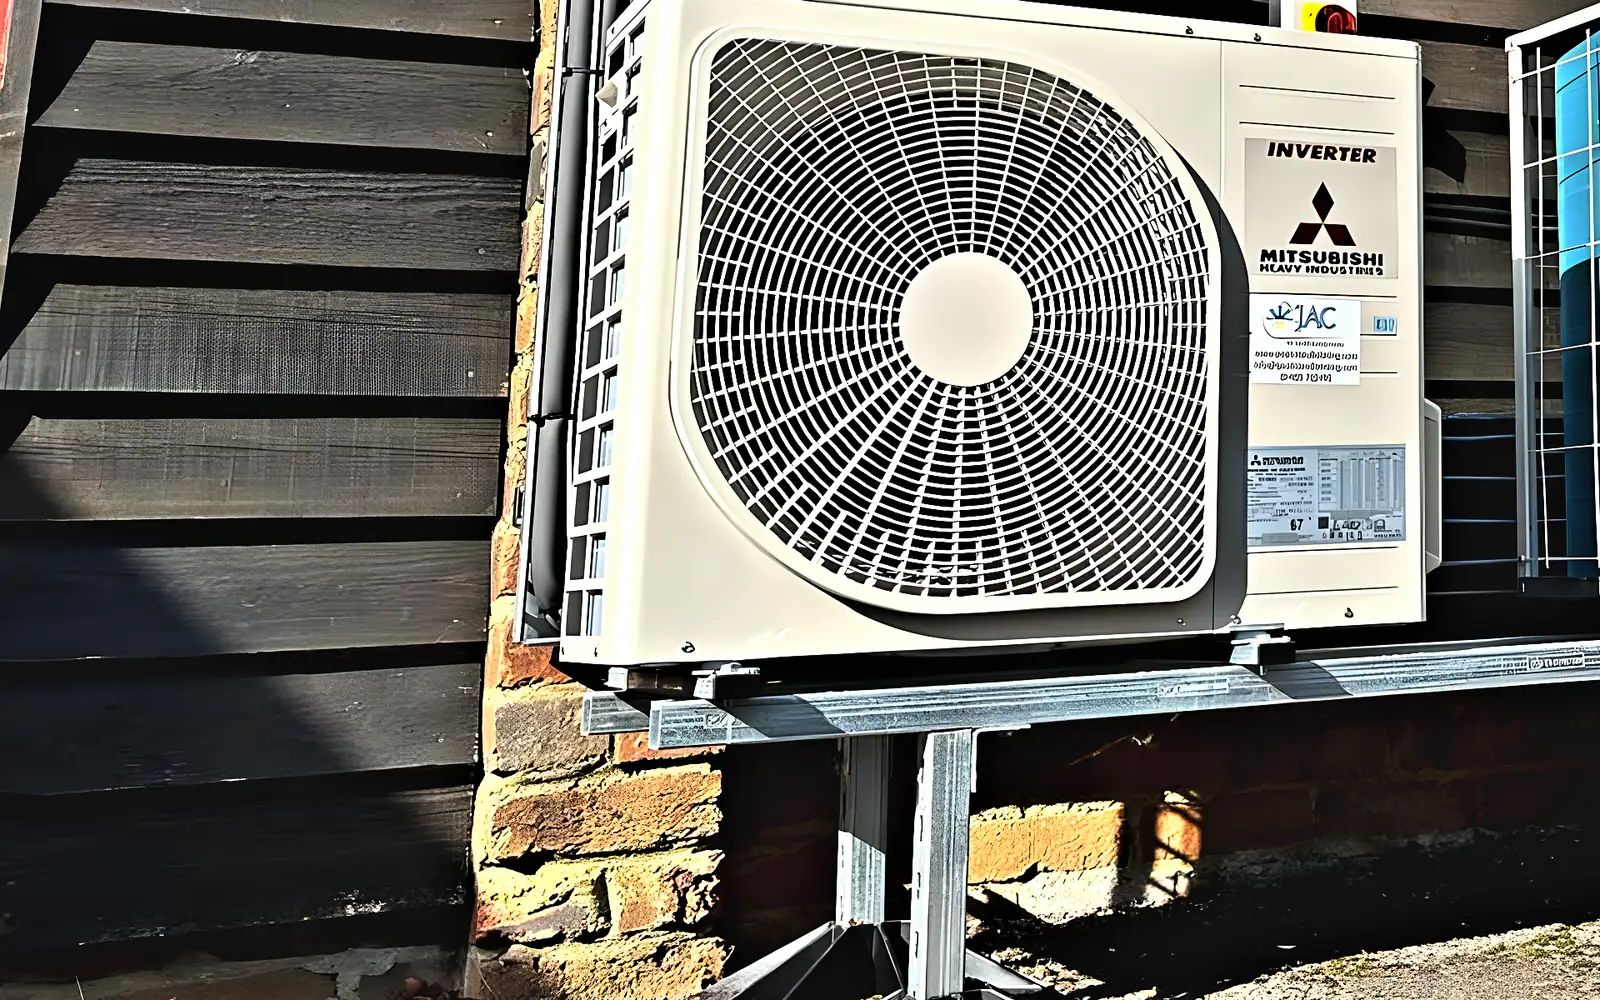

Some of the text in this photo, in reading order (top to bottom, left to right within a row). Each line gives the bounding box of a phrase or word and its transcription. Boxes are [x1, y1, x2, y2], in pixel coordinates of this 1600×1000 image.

[1267, 142, 1377, 163] INVERTER
[1259, 249, 1384, 267] MITSUBISHI
[1259, 264, 1302, 274] HEAVY
[1294, 304, 1337, 333] JAC
